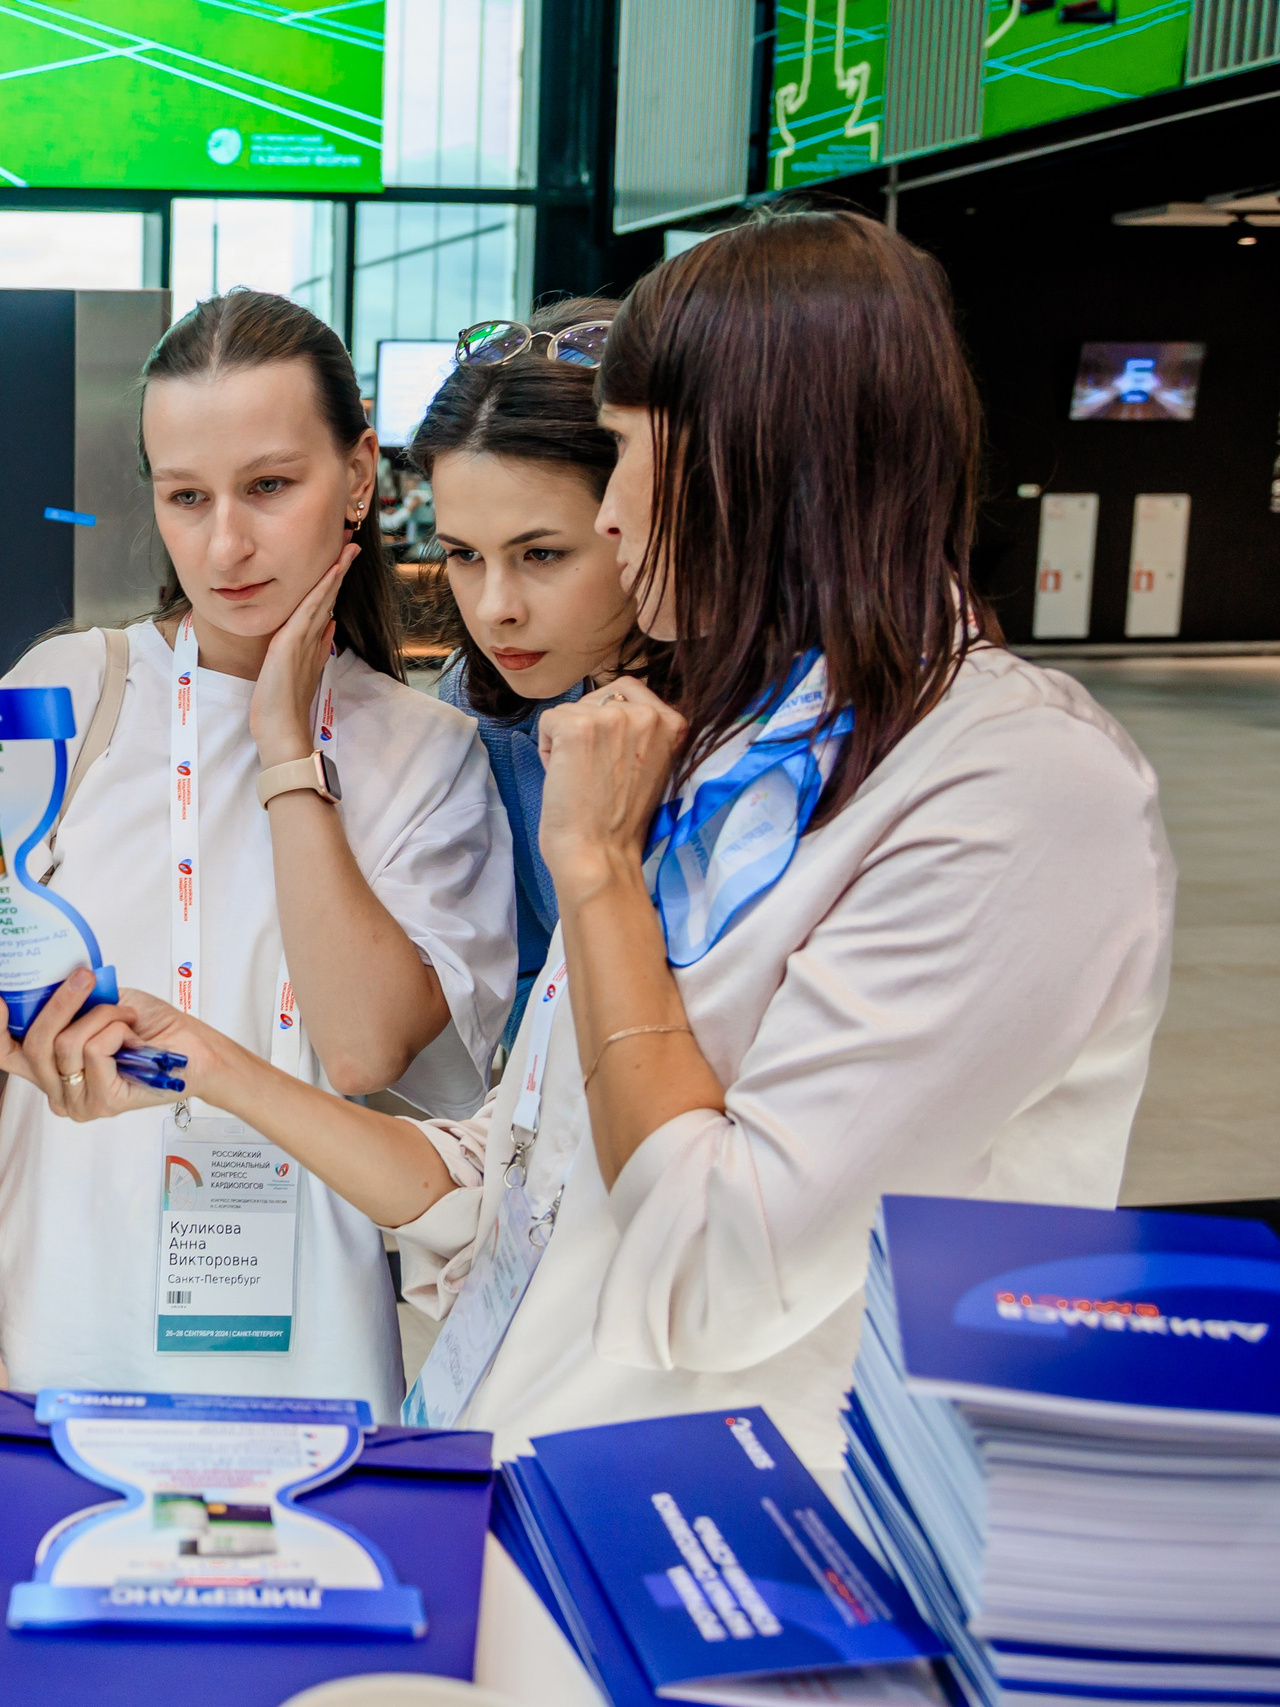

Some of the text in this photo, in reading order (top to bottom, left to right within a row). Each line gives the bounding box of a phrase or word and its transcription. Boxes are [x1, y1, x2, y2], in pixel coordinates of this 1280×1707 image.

[212, 1150, 262, 1158] РОССИЙСКИЙ
[211, 1160, 270, 1169] НАЦИОНАЛЬНЫЙ
[210, 1182, 264, 1190] КАРДИОЛОГОВ
[170, 1220, 242, 1237] Куликова
[168, 1237, 206, 1250] Анна
[169, 1252, 258, 1270] Викторовна
[167, 1274, 262, 1286] Санкт-Петербург
[232, 1330, 284, 1338] САНКТ-ПЕТЕРБУРГ
